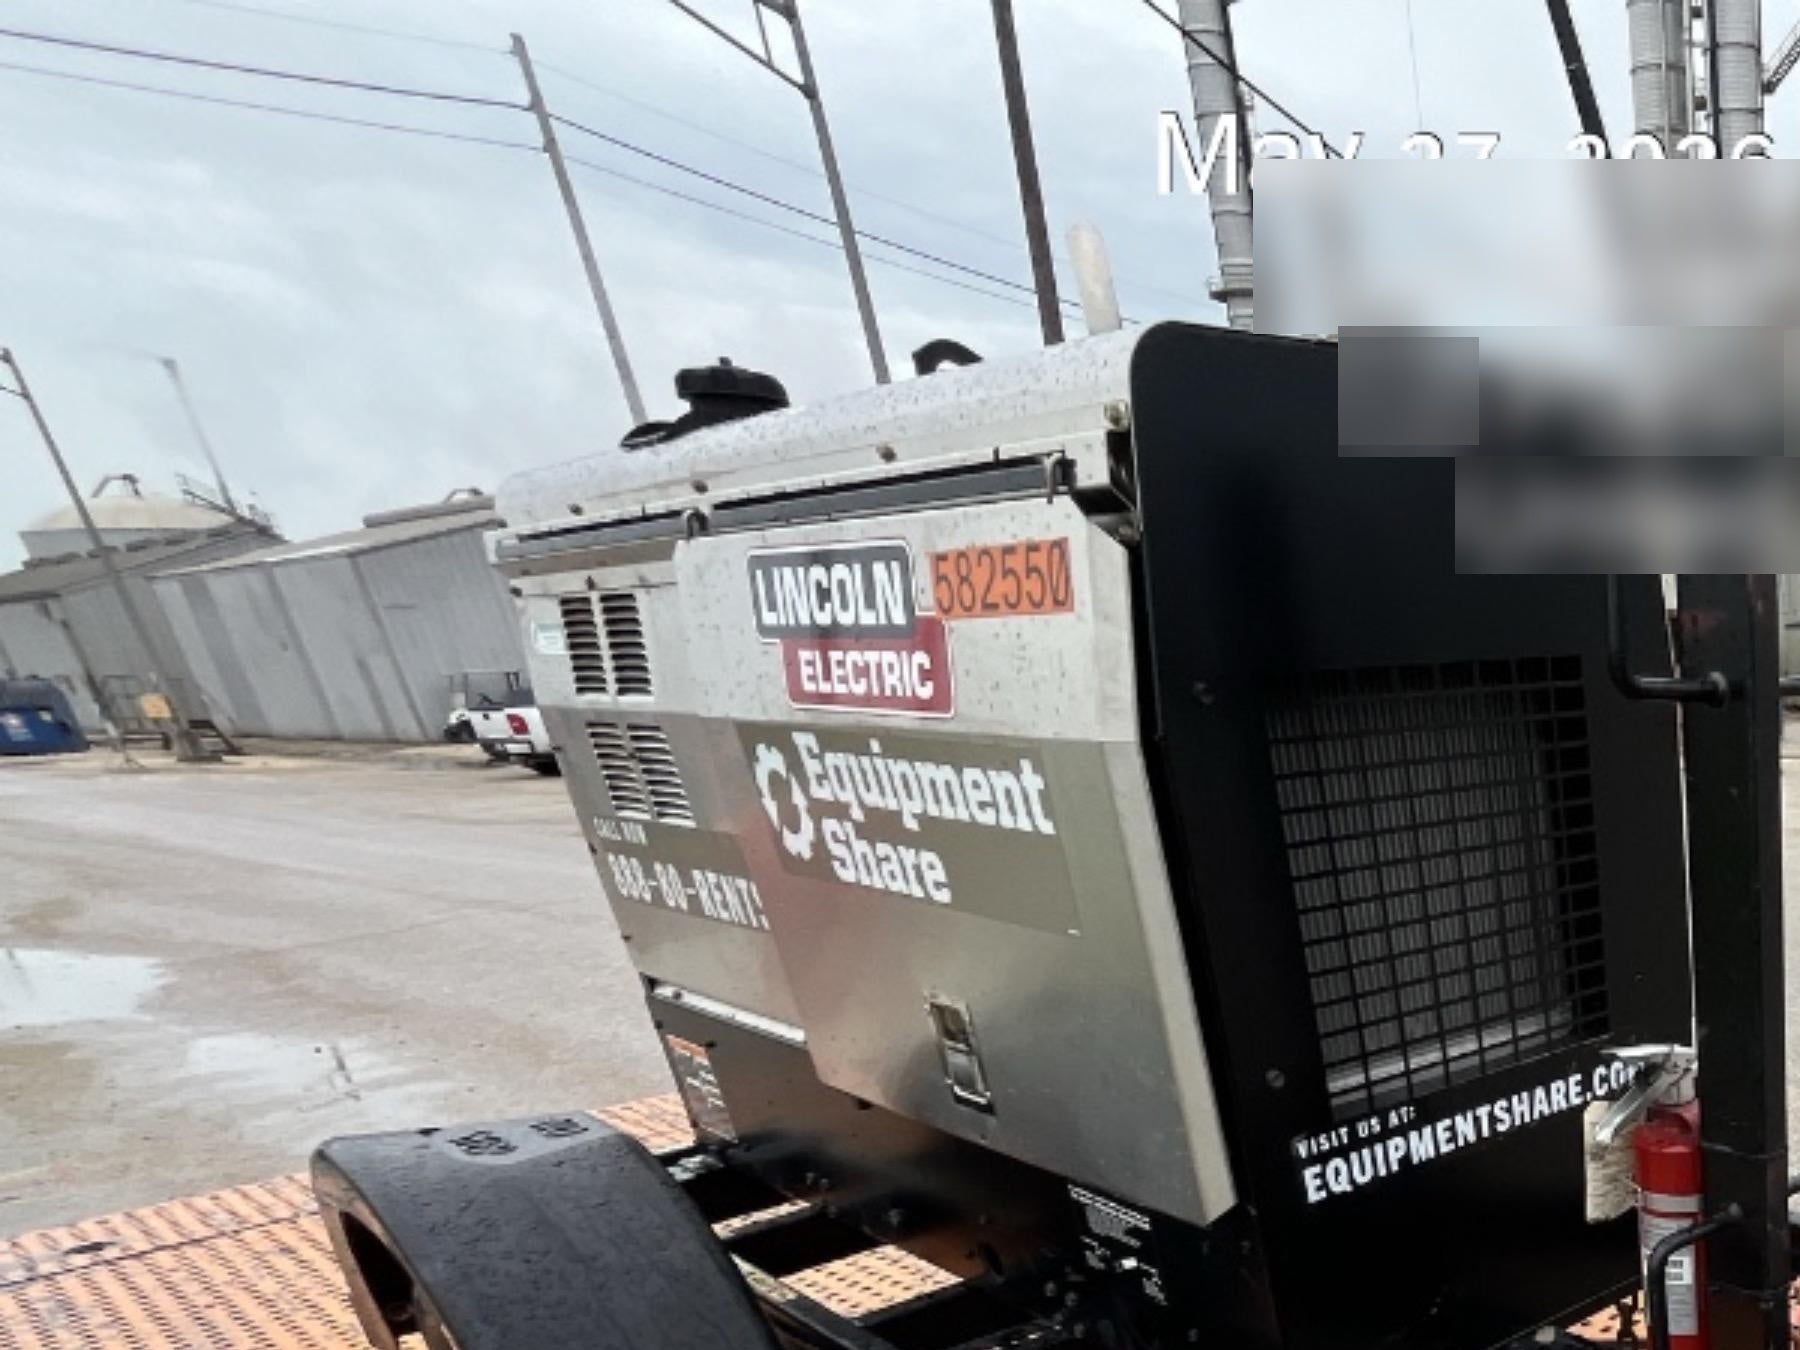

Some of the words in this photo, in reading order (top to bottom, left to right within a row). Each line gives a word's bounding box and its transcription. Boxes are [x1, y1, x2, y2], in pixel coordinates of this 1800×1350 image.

[755, 559, 907, 626] LINCOLN
[934, 541, 1070, 616] 582550
[798, 650, 934, 700] ELECTRIC
[791, 731, 1056, 835] Equipment
[821, 818, 952, 904] Share
[1295, 1126, 1349, 1160] VISIT
[1356, 1115, 1382, 1140] US
[1387, 1104, 1417, 1130] AT:
